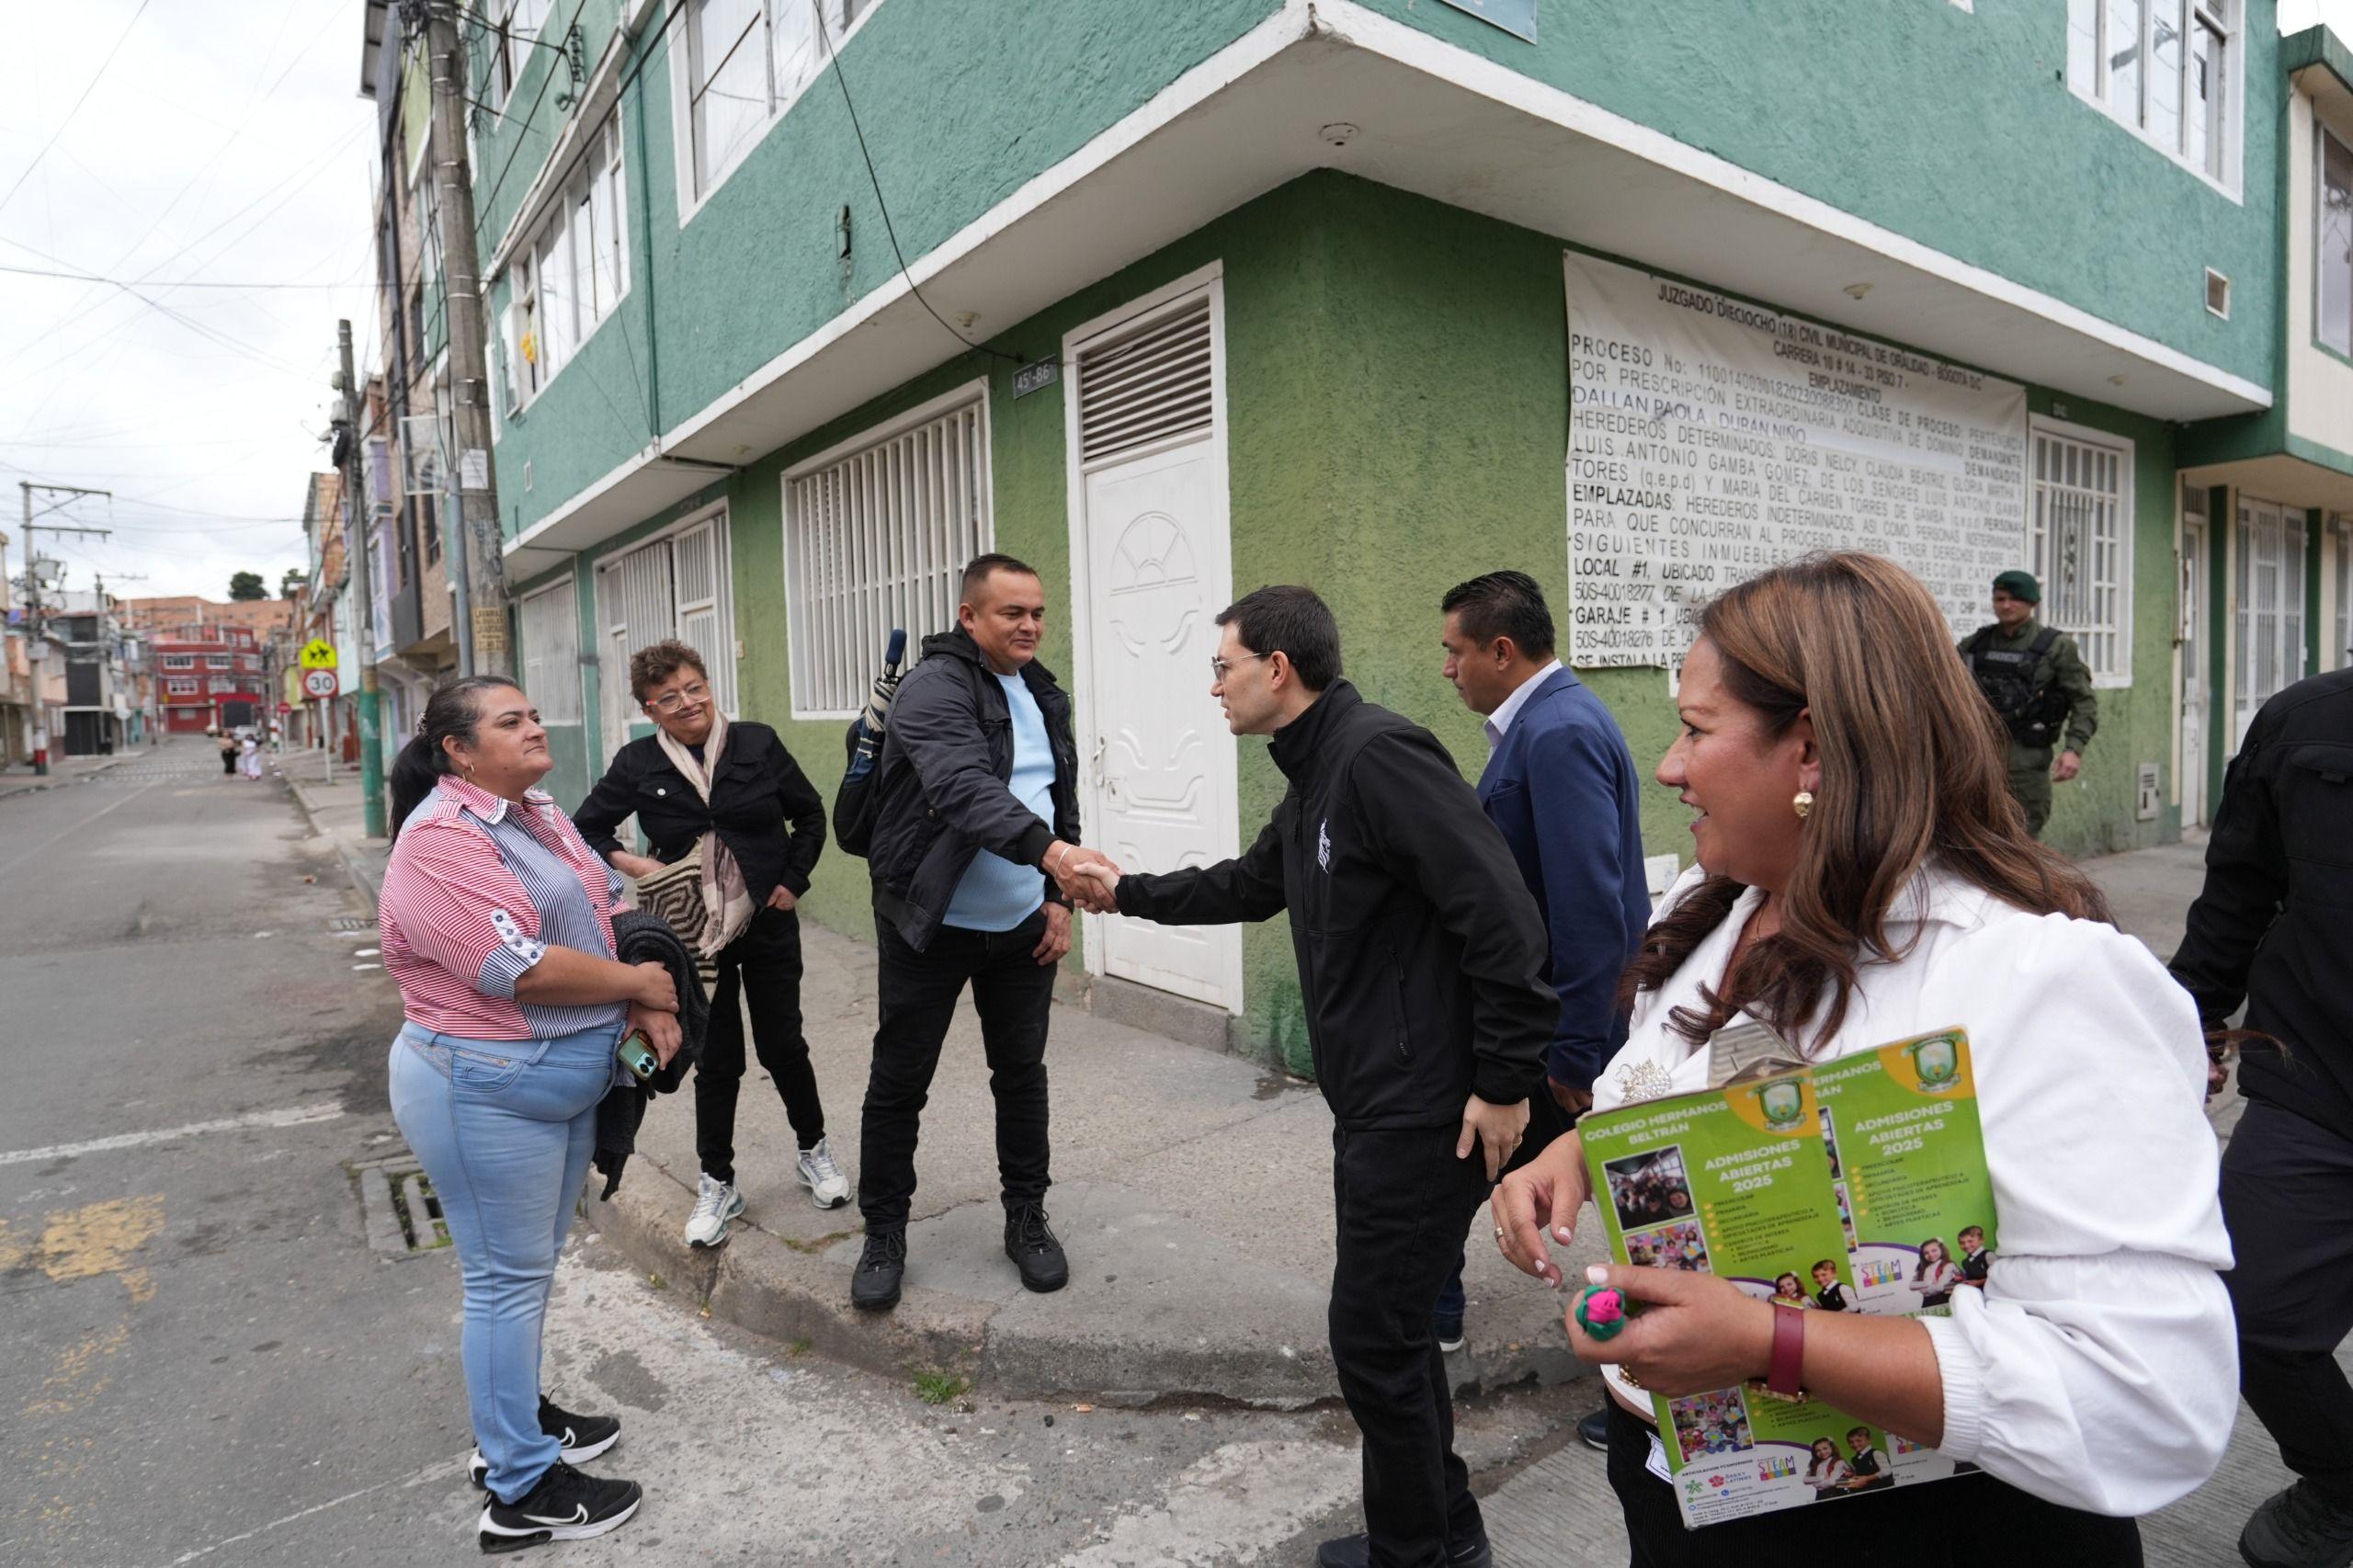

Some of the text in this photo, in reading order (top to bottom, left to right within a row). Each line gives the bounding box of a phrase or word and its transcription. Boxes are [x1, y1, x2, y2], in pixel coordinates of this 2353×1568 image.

[1657, 285, 1713, 314] JUZGADO
[1717, 301, 1776, 333] DIECIOCHO
[1778, 322, 1796, 341] (18)
[1799, 325, 1823, 347] CIVIL
[1825, 333, 1872, 360] MUNICIPAL
[1875, 347, 1888, 364] DE
[1773, 340, 1820, 368] CARRERA
[1877, 368, 1895, 387] PISO
[1572, 334, 1654, 367] PROCESO
[1664, 354, 1688, 376] No:
[1858, 401, 1891, 423] CLASE
[1898, 410, 1911, 427] DE
[1809, 371, 1881, 403] EMPLAZAMIENTO
[1572, 359, 1607, 382] POR
[1620, 367, 1725, 406] PRESCRIPCIÓN
[1735, 393, 1836, 434] EXTRAORDINARIA
[1843, 415, 1903, 443] ADQUISITIVA
[1908, 431, 1921, 449] DE
[1572, 386, 1648, 414] DALLAN
[1654, 399, 1707, 424] PAOLA
[1772, 419, 1806, 445] NIÑO
[1573, 410, 1667, 440] HEREDEROS
[1785, 446, 1818, 466] DORIS
[1866, 460, 1904, 482] CLAUDIA
[1574, 434, 1614, 456] LUIS
[1626, 441, 1698, 468] ANTONIO
[1709, 453, 1756, 476] GAMBA
[1821, 472, 1835, 490] DE
[1843, 477, 1864, 494] LOS
[1871, 478, 1919, 502] SEÑORES
[1926, 491, 1948, 506] LUIS
[1573, 459, 1628, 483] TORES
[1641, 467, 1696, 494] (q.e.p.d)
[1705, 475, 1713, 492] Y
[1722, 477, 1760, 499] MARIA
[1769, 483, 1790, 504] DEL
[1798, 489, 1843, 511] CARMEN
[1849, 496, 1888, 517] TORRES
[1894, 503, 1907, 520] DE
[1913, 506, 1945, 524] GAMBA
[1574, 483, 1676, 512] EMPLAZADAS:
[1686, 495, 1759, 521] HEREDEROS
[1883, 520, 1910, 539] COMO
[1915, 524, 1961, 543] PERSONAS
[1574, 507, 1617, 530] PARA
[1626, 512, 1659, 534] QUE
[1669, 517, 1752, 541] CONCURRAN
[1759, 526, 1773, 544] AL
[1781, 528, 1834, 549] PROCESO
[1896, 540, 1927, 559] TENER
[1574, 532, 1689, 559] SIGUIENTES
[1574, 557, 1620, 576] LOCAL
[1632, 560, 1651, 581] #1,
[1662, 562, 1714, 582] UBICADO
[1575, 579, 1656, 601] 50S-40018277
[1664, 585, 1683, 602] DE
[1690, 588, 1707, 604] LA
[1575, 607, 1631, 625] GARAJE
[1642, 608, 1649, 622] #
[1659, 608, 1665, 624] 1
[1576, 629, 1693, 649] 50S-40018276 DE LA
[311, 676, 332, 690] 30
[1813, 1061, 1882, 1085] ERMANOS
[1585, 1101, 1728, 1141] COLEGIO HERMANOS
[1855, 1101, 1954, 1132] ADMISIONES
[1869, 1119, 1945, 1145] ABIERTAS
[1705, 1140, 1801, 1171] ADMISIONES
[1882, 1137, 1923, 1156] 2025
[1720, 1156, 1793, 1182] ABIERTAS
[1733, 1174, 1772, 1193] 2025
[1861, 1259, 1902, 1281] STEAM
[1757, 1455, 1797, 1474] STEAM
